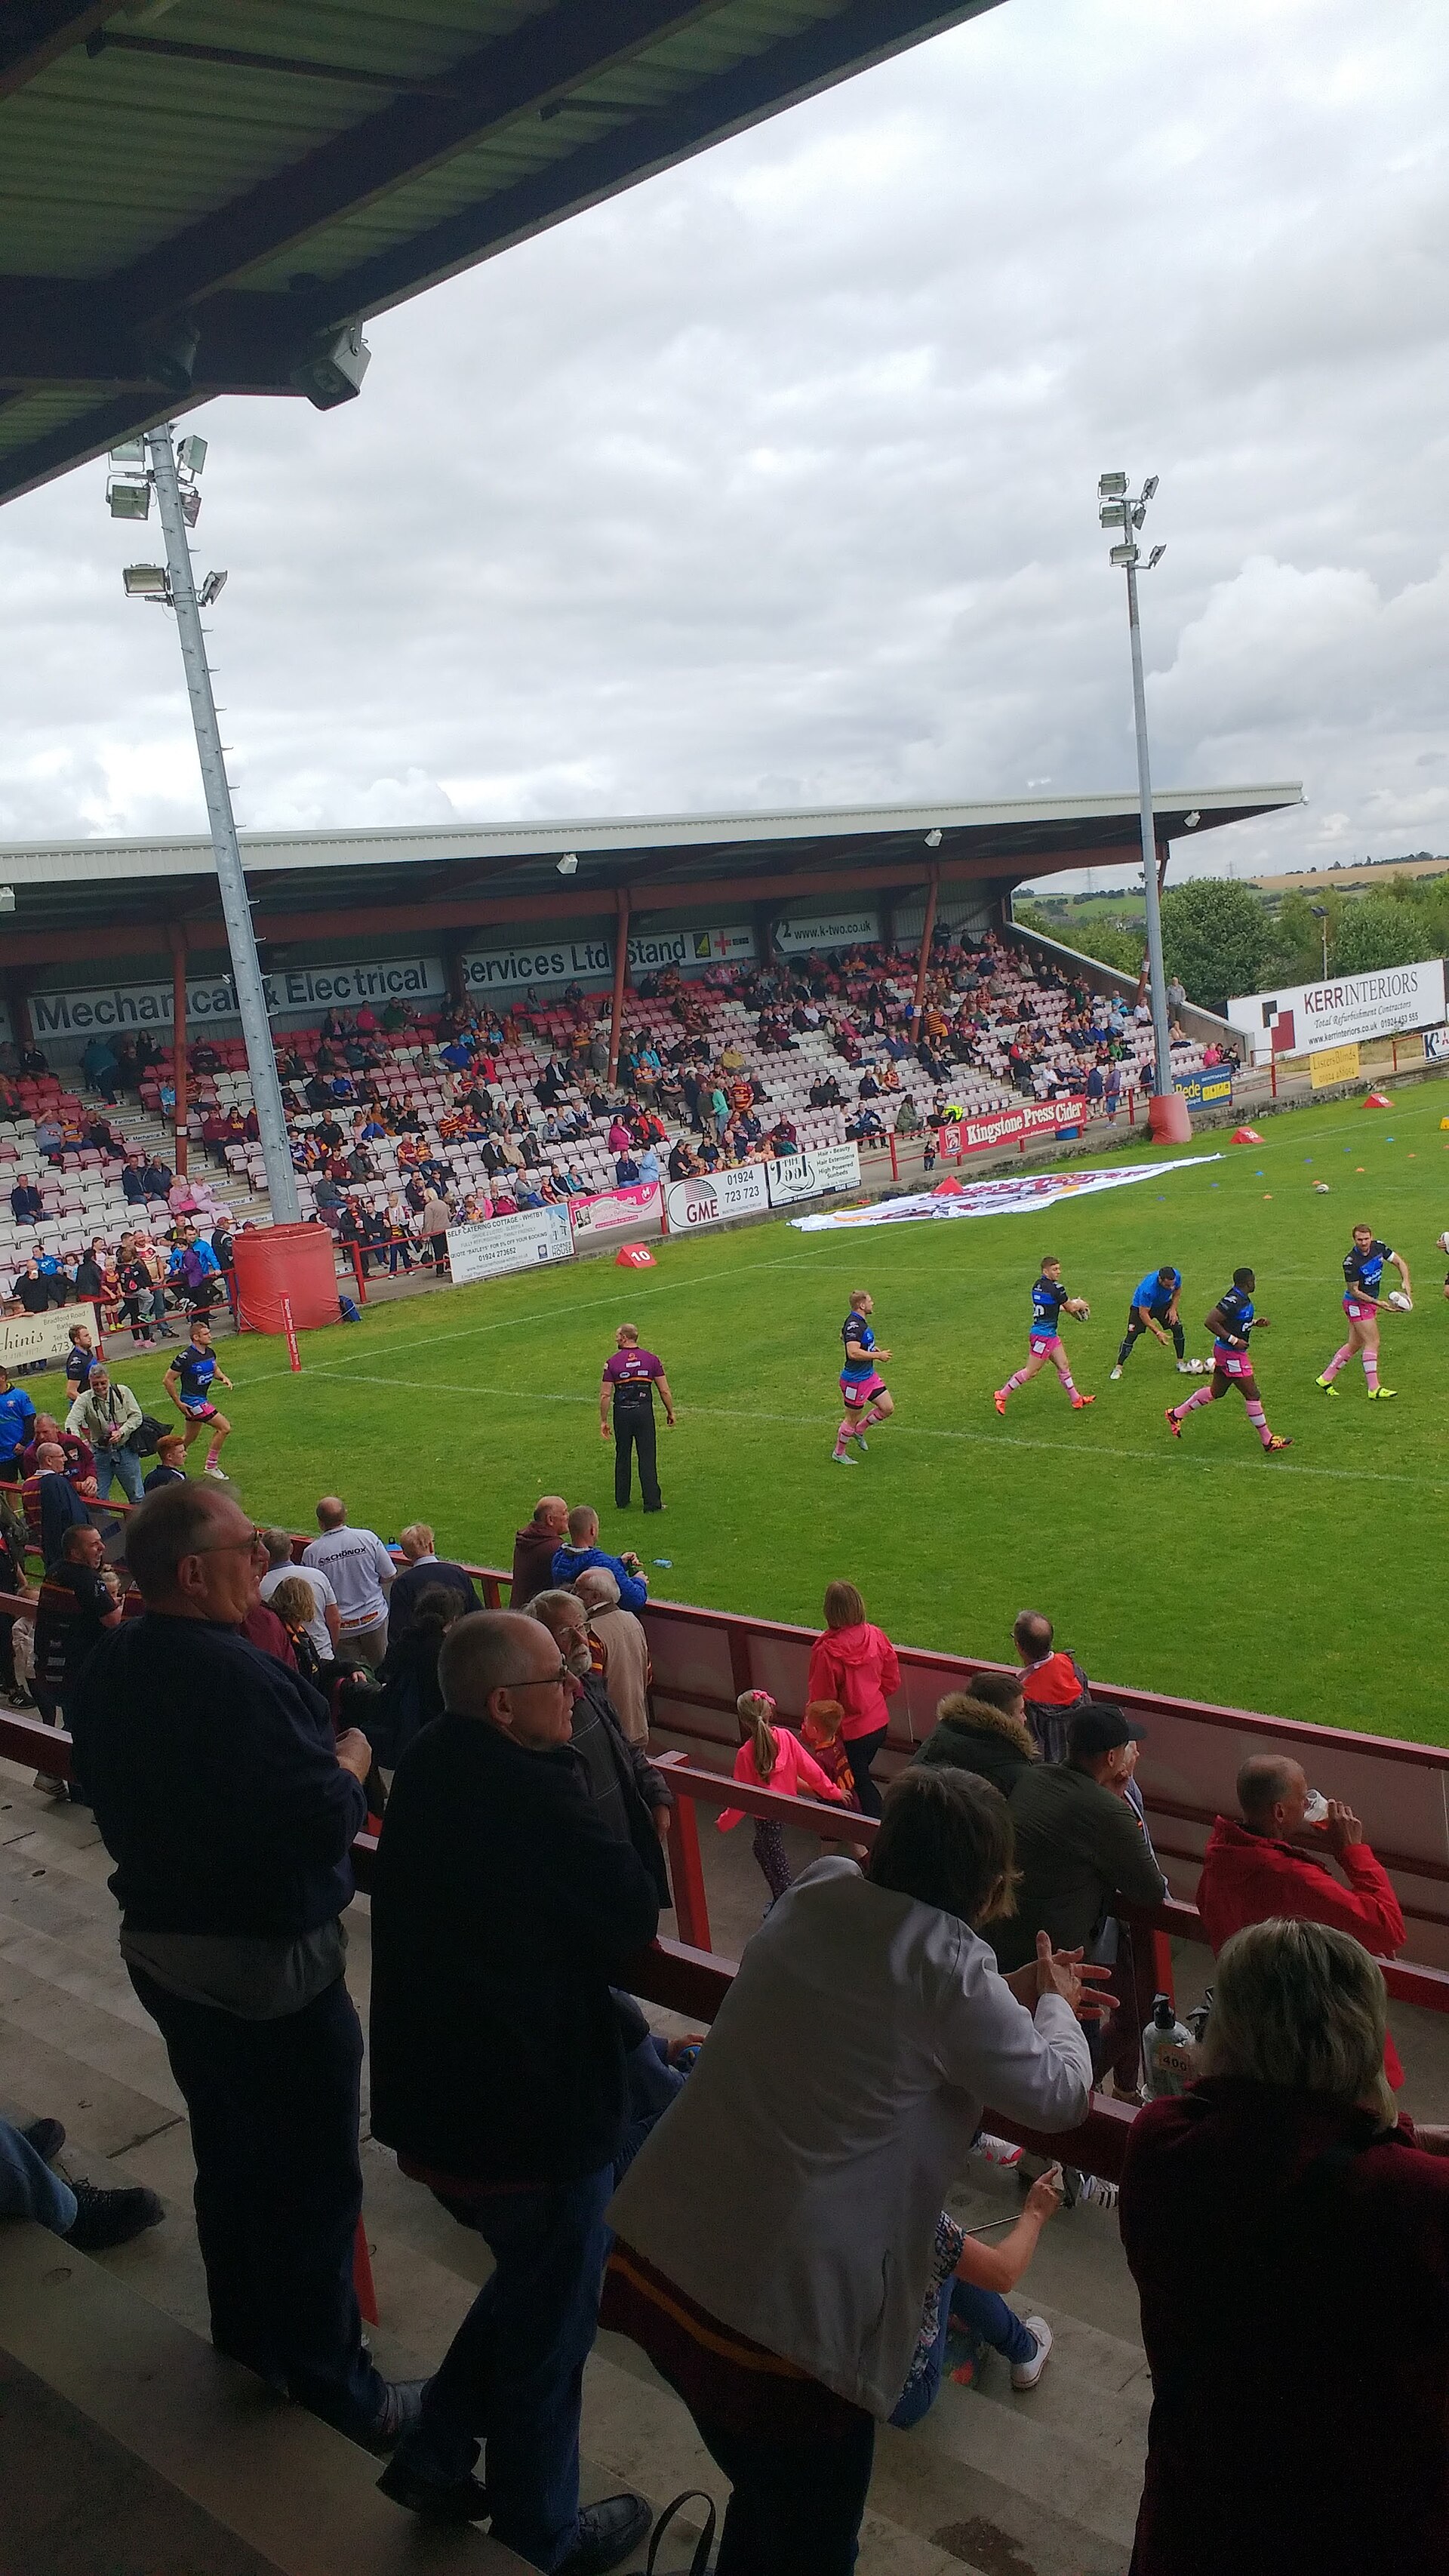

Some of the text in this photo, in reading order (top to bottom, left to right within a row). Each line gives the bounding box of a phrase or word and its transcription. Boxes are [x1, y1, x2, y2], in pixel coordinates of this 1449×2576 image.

[794, 919, 872, 940] www.k-two.co.uk
[571, 941, 611, 972] Ltd
[626, 934, 687, 966] Stand
[35, 986, 240, 1032] Mechancal
[285, 960, 428, 1005] Electrical
[1314, 1001, 1412, 1029] Total Refurbishment Contractors
[1308, 1023, 1378, 1045] www.kerrinteriors.co.uk
[1409, 1011, 1419, 1021] 555
[966, 1115, 1024, 1146] Kingstone
[1023, 1104, 1055, 1128] Press
[1056, 1100, 1083, 1123] Cider
[817, 1146, 851, 1158] Hair Beauty
[816, 1153, 855, 1167] Hair Extensions
[818, 1161, 854, 1175] High Powered
[826, 1169, 848, 1180] Sunbeds
[727, 1170, 754, 1186] 01924
[724, 1190, 741, 1204] 723
[743, 1185, 760, 1199] 723
[687, 1199, 719, 1223] GME
[448, 1211, 544, 1239] SELF CATERING COTTAGE WHITBY
[515, 1236, 528, 1244] YOUR
[528, 1231, 548, 1241] BOOKING
[478, 1247, 517, 1262] 01924 273652
[552, 1246, 573, 1257] HOUSE
[630, 1250, 651, 1261] 10
[43, 1314, 69, 1325] Bradford
[70, 1310, 86, 1319] Road
[325, 1547, 367, 1562] SCHÖNOX
[1163, 2056, 1187, 2071] 400
